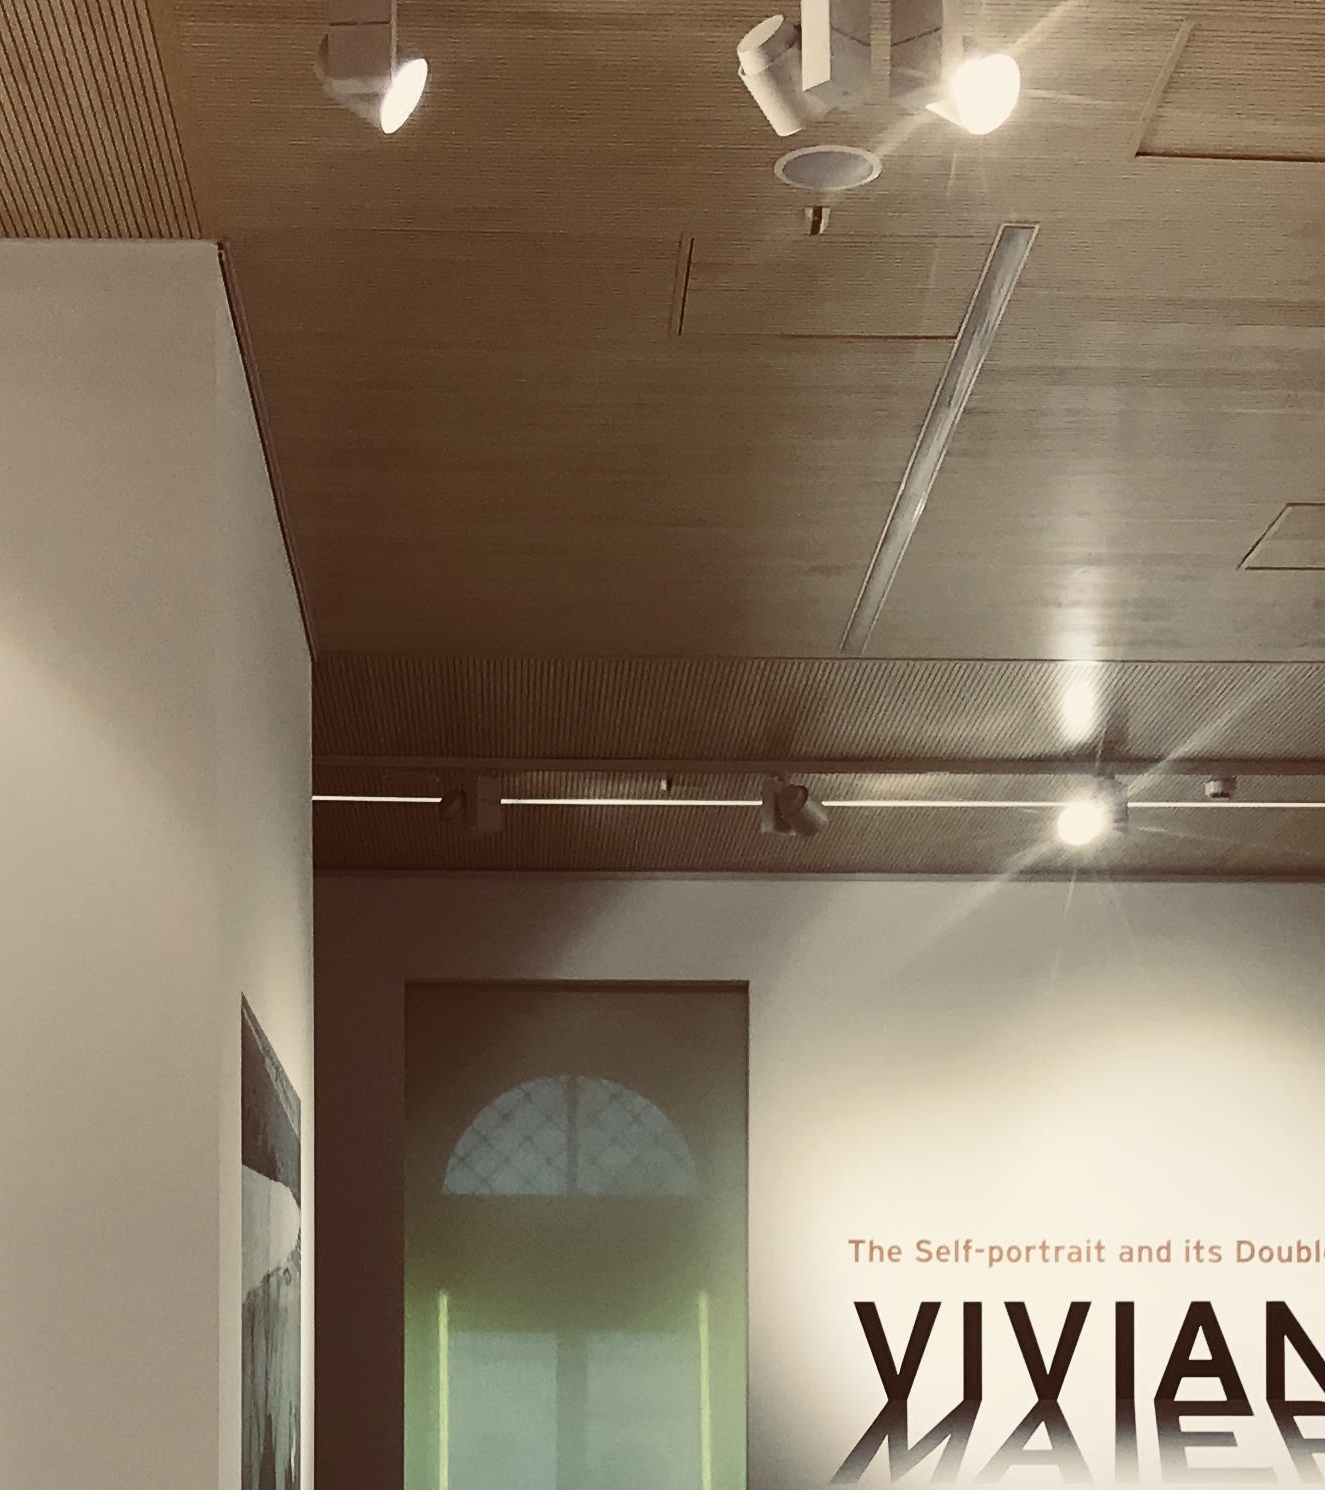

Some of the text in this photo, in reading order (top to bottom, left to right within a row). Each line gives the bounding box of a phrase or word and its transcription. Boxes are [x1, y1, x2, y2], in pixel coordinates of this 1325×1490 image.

[848, 1239, 902, 1262] The
[915, 1239, 1105, 1267] Self-portrait
[1118, 1239, 1172, 1262] and
[1184, 1239, 1222, 1262] its
